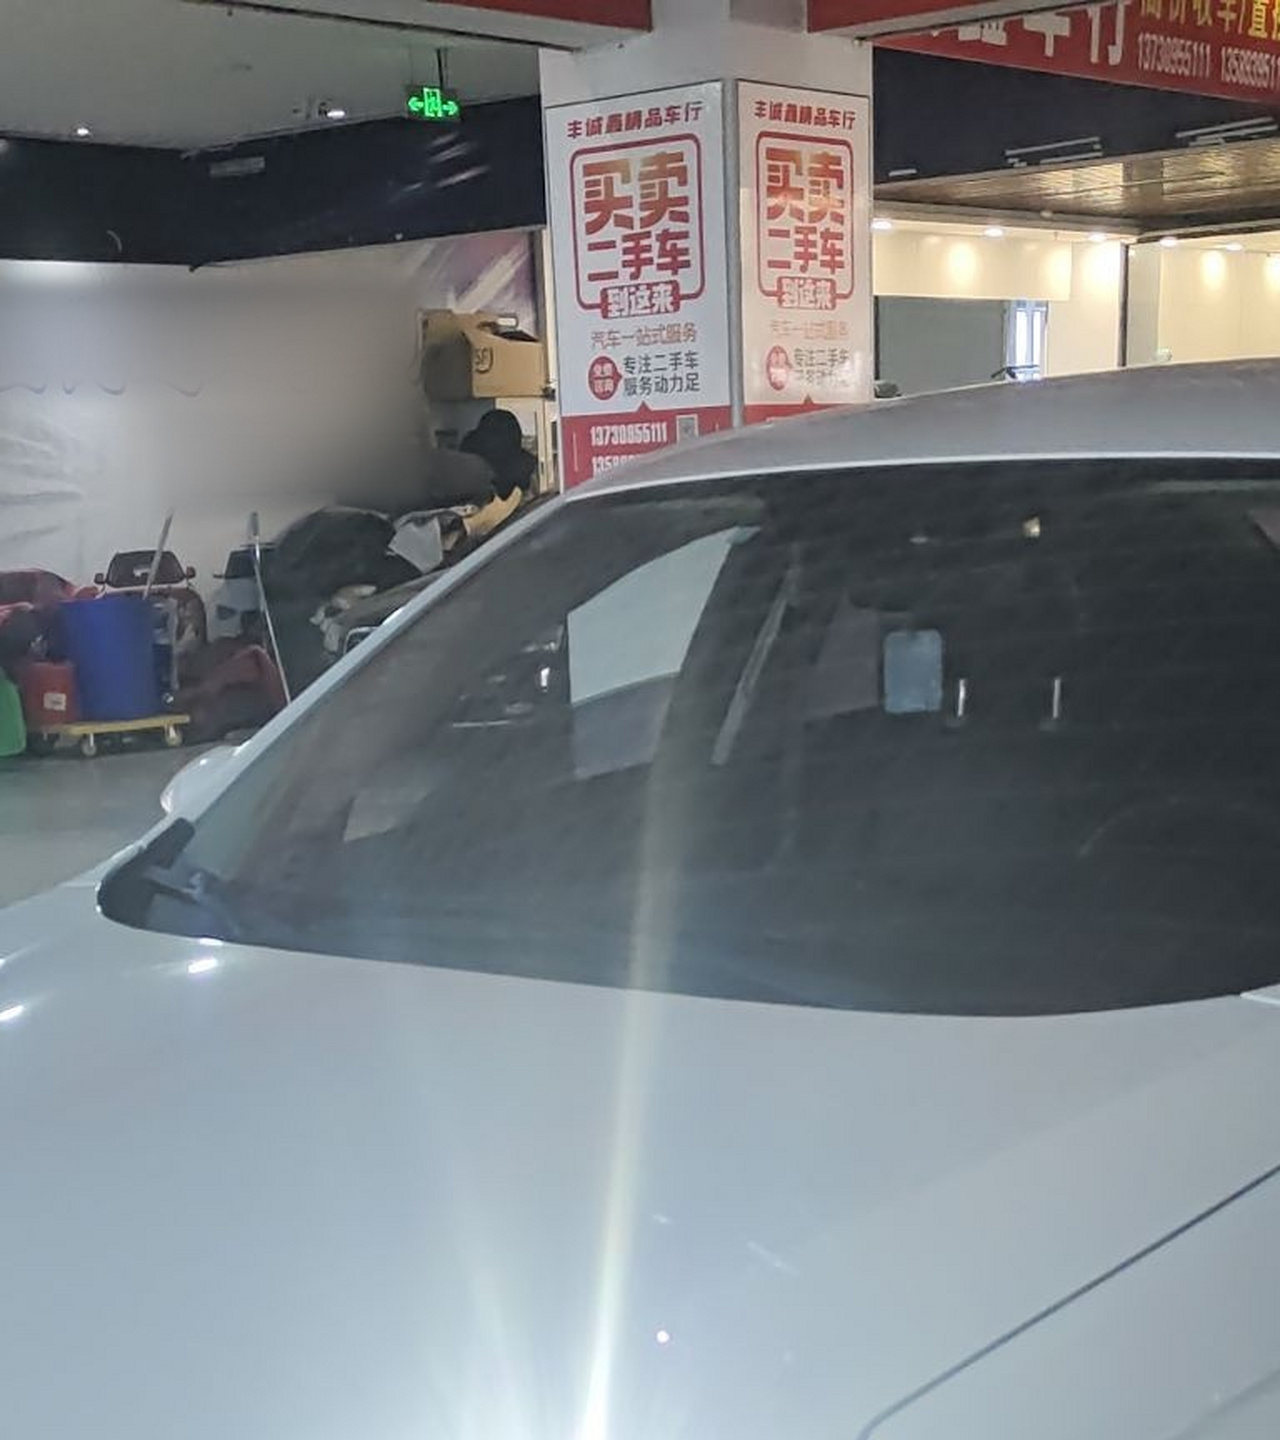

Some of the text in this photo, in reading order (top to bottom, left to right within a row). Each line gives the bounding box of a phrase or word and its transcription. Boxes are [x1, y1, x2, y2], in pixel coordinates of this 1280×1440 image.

[583, 152, 689, 236] 买卖
[766, 147, 844, 225] 买卖
[587, 227, 691, 281] 二手车
[767, 227, 845, 275] 二手车
[591, 322, 697, 350] 汽车一站式服务
[623, 350, 699, 375] 专注二手车
[623, 372, 701, 396] 服务动力足
